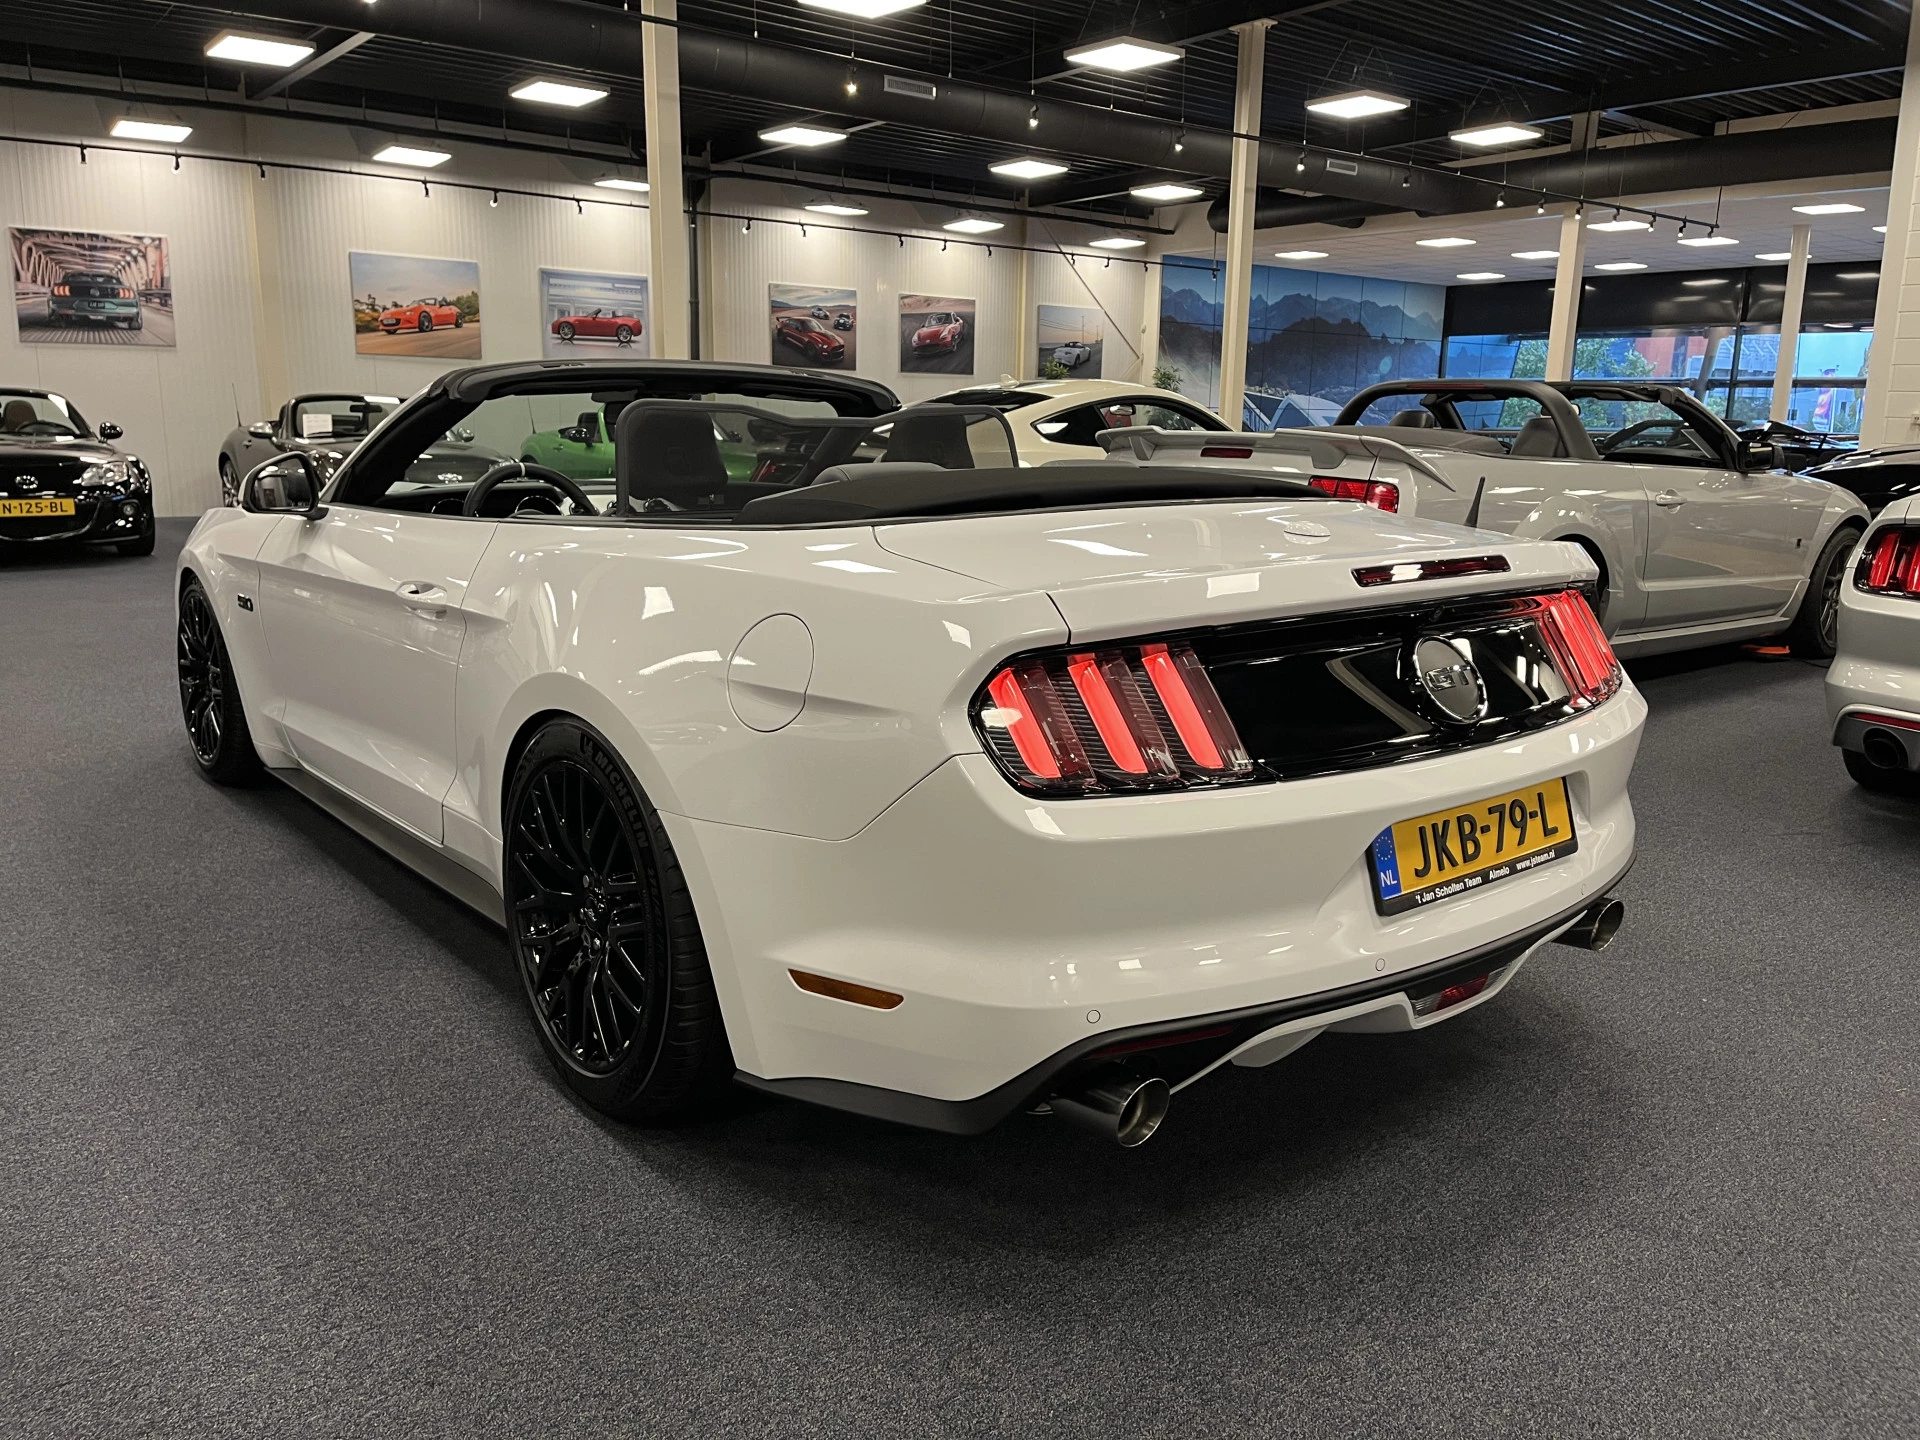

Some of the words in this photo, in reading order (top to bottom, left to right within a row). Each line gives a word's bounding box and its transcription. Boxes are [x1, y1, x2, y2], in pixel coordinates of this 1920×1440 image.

[2, 502, 68, 514] N-125-BL
[1425, 664, 1471, 691] GT
[594, 750, 649, 848] MICHELIN
[1414, 791, 1559, 878] JKB-79-L
[1380, 869, 1398, 888] NL
[1422, 890, 1435, 902] Jan
[1435, 882, 1465, 897] Scholten
[1465, 876, 1482, 888] Team
[1489, 866, 1510, 879] Almelo
[1516, 849, 1555, 870] www.jsteam.nl
